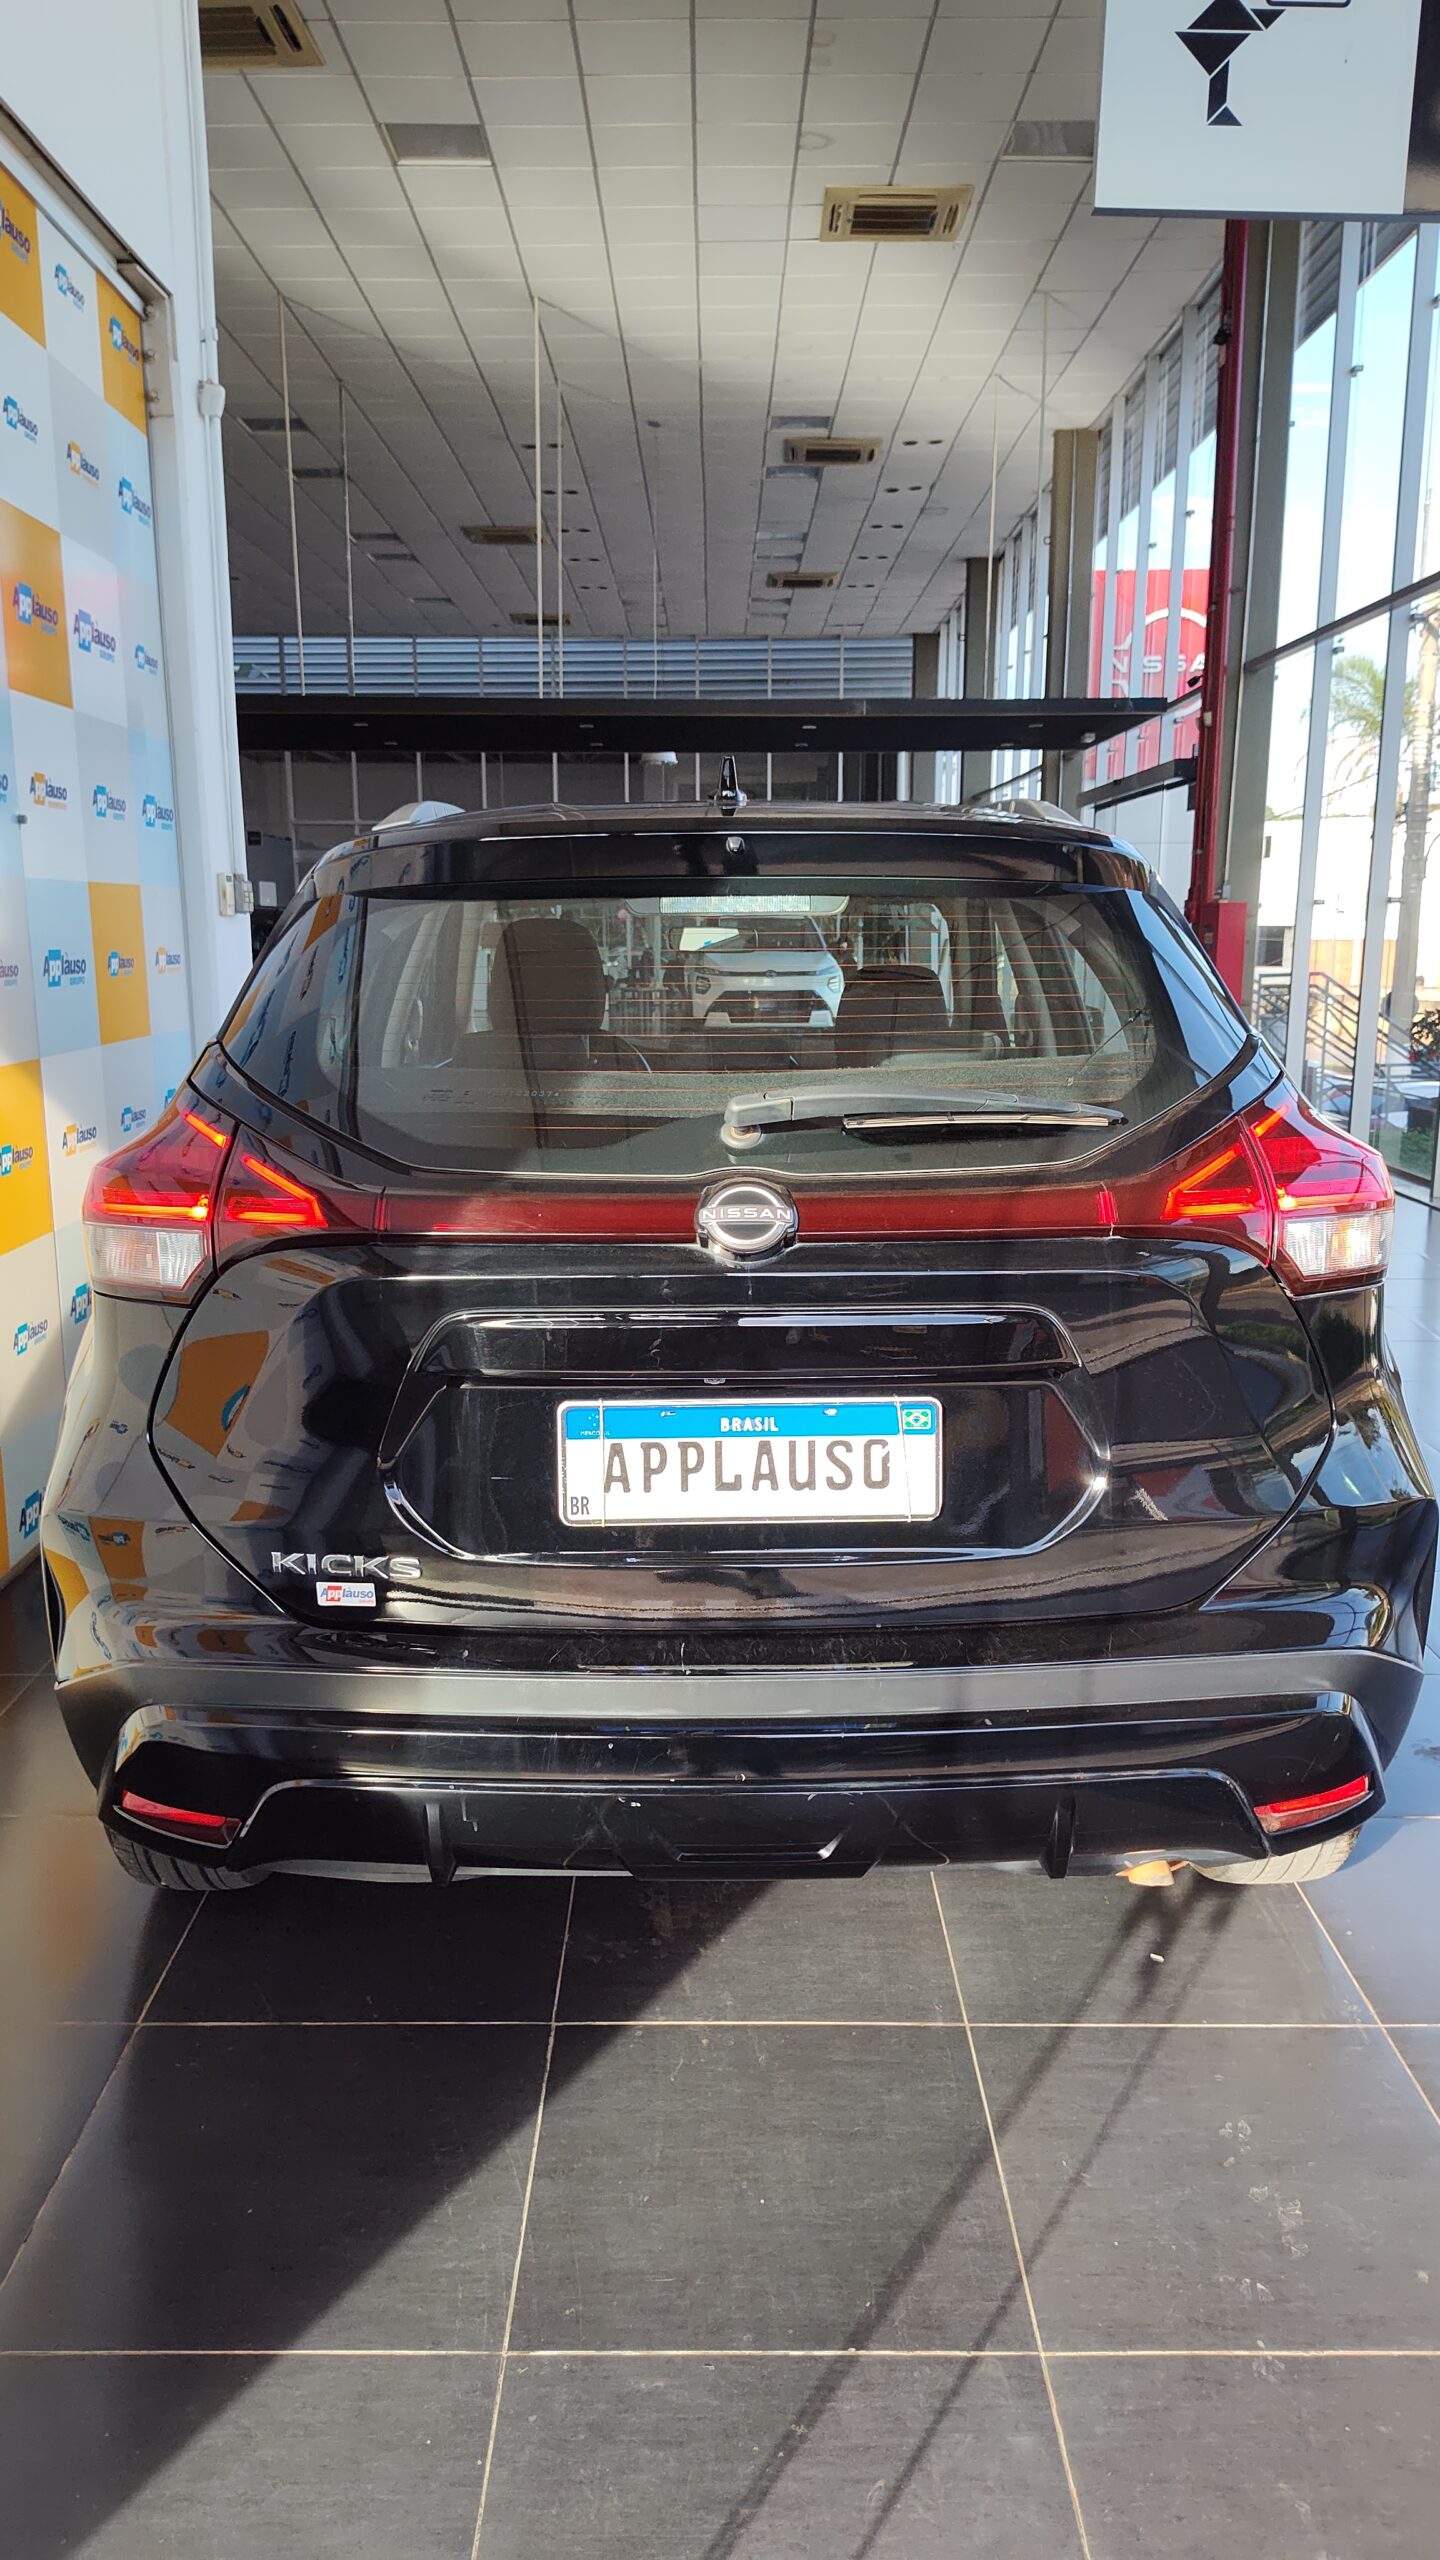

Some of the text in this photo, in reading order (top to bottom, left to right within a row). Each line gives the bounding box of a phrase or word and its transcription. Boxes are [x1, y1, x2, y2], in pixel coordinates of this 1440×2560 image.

[1112, 653, 1206, 674] NSSA
[702, 1207, 791, 1220] NISSAN
[720, 1416, 779, 1433] BRASIL
[604, 1439, 890, 1493] APPLAUSO
[570, 1496, 590, 1515] BR
[270, 1551, 423, 1580] KICKS
